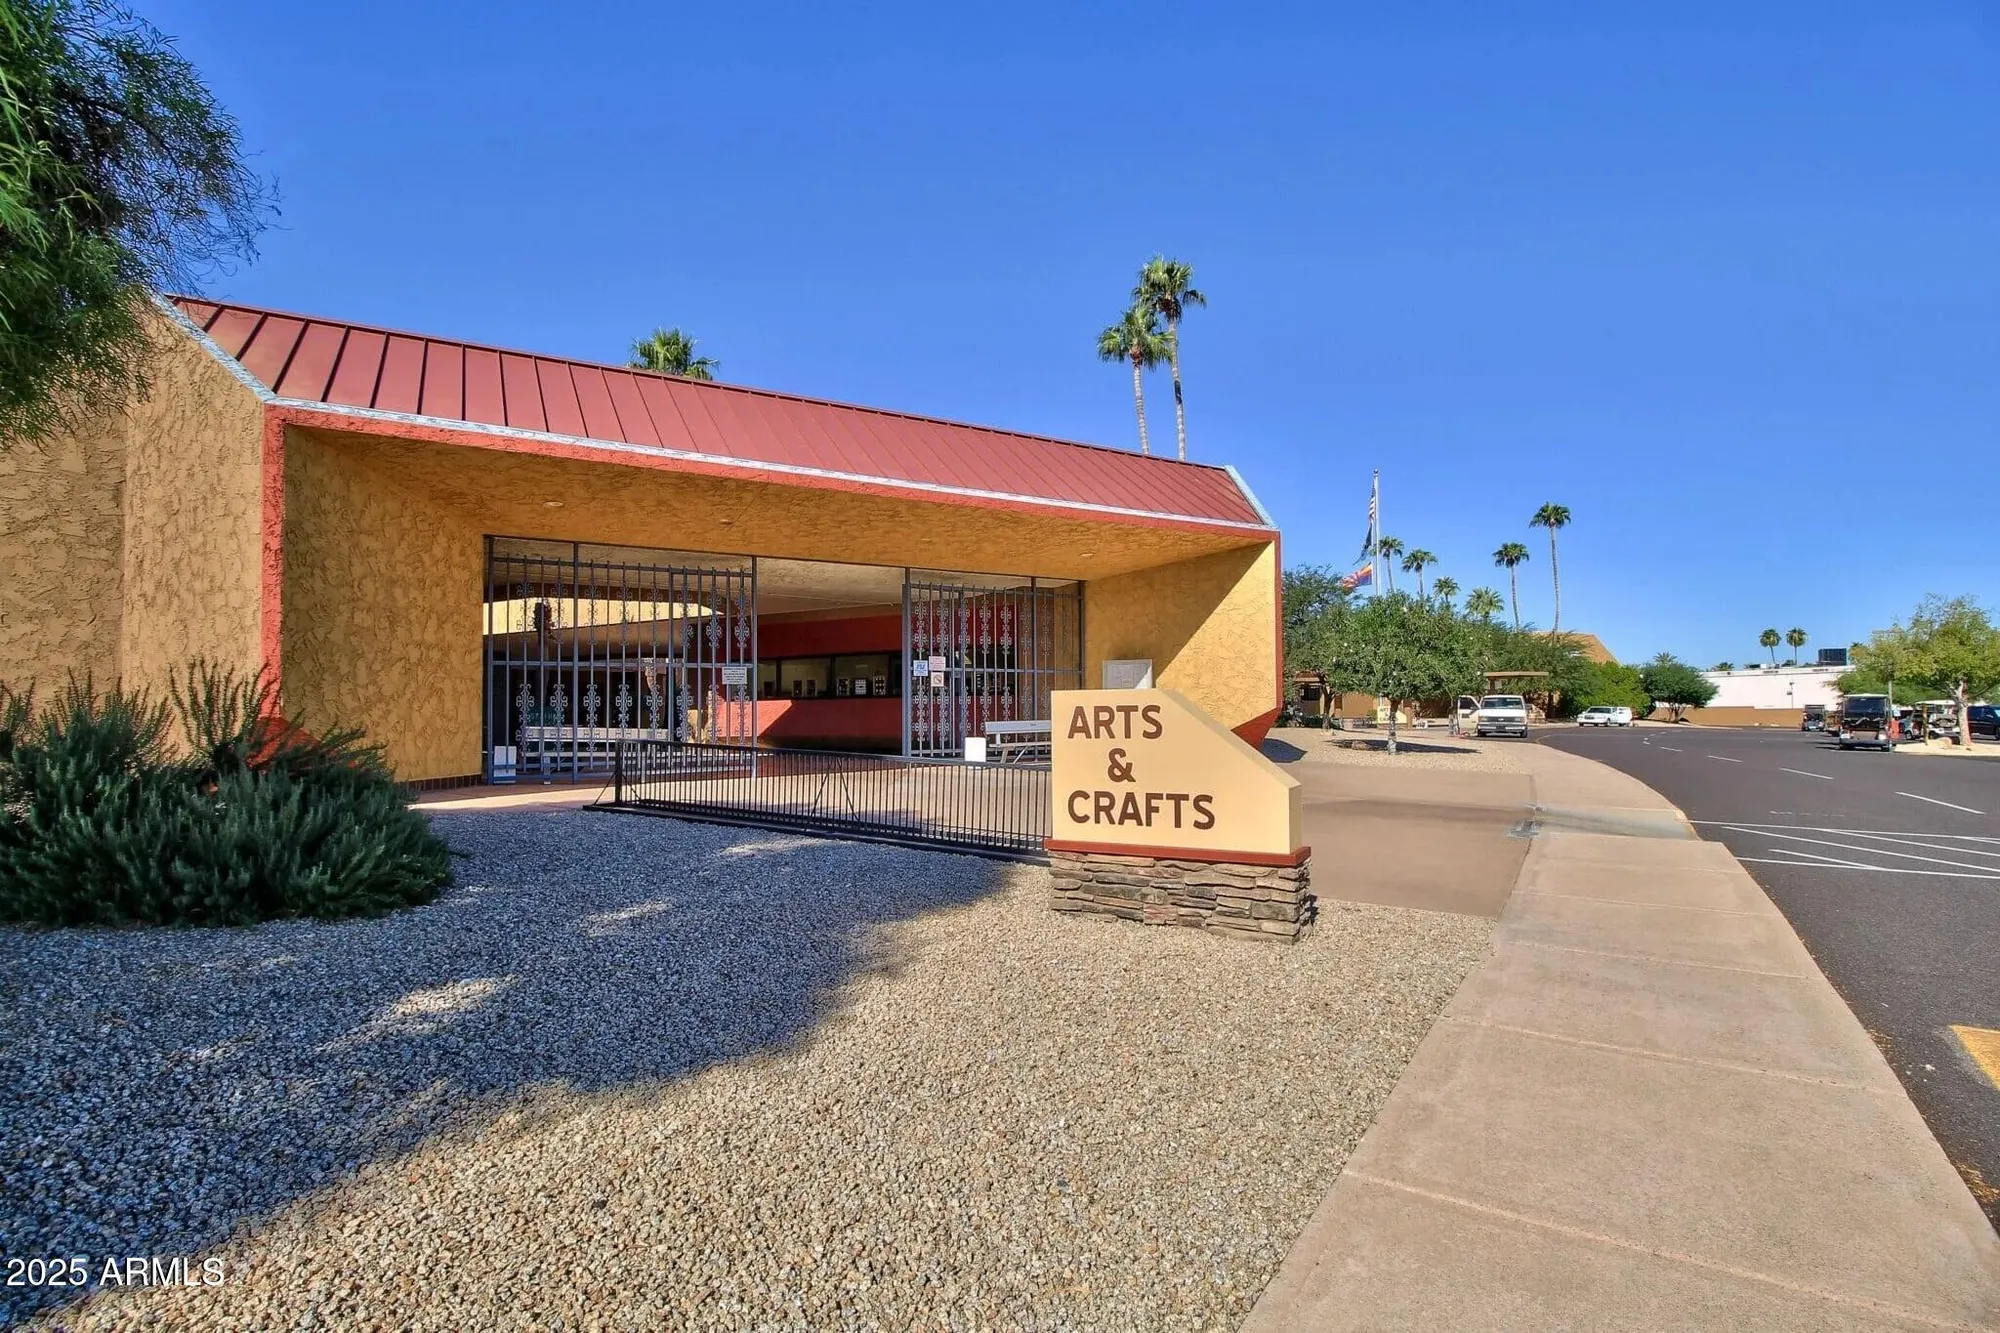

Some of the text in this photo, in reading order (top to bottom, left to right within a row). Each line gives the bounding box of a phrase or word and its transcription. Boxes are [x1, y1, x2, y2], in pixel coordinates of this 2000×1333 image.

[1067, 704, 1163, 740] ARTS
[1107, 747, 1137, 783] &
[1067, 789, 1216, 830] CRAFTS
